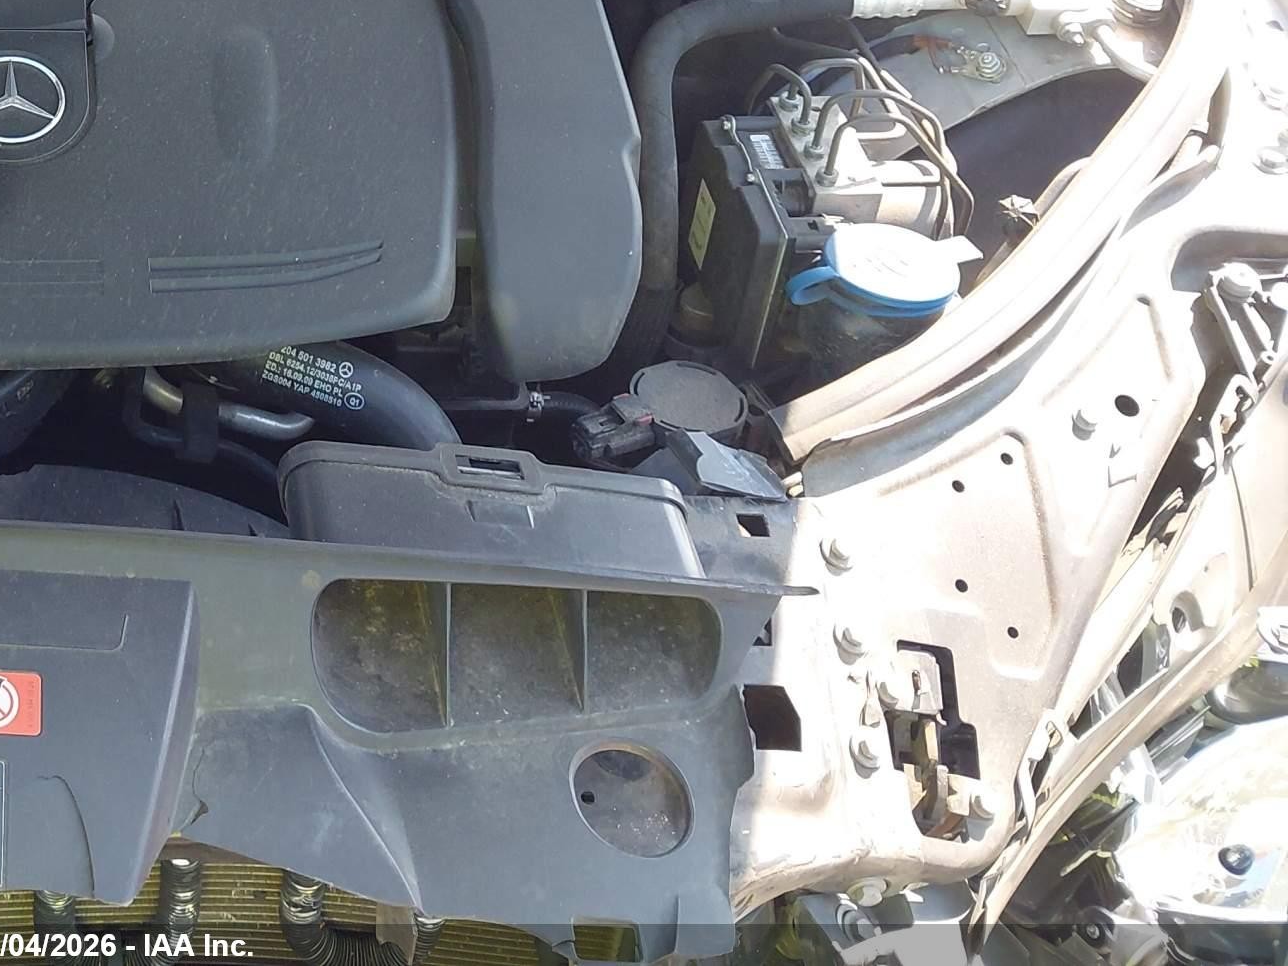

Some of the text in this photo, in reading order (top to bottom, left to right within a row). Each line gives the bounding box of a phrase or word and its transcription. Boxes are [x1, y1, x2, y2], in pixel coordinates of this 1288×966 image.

[269, 352, 284, 364] DBL
[315, 358, 337, 373] 3982
[293, 382, 310, 394] YAP
[333, 387, 343, 397] PL
[349, 397, 360, 406] Q1
